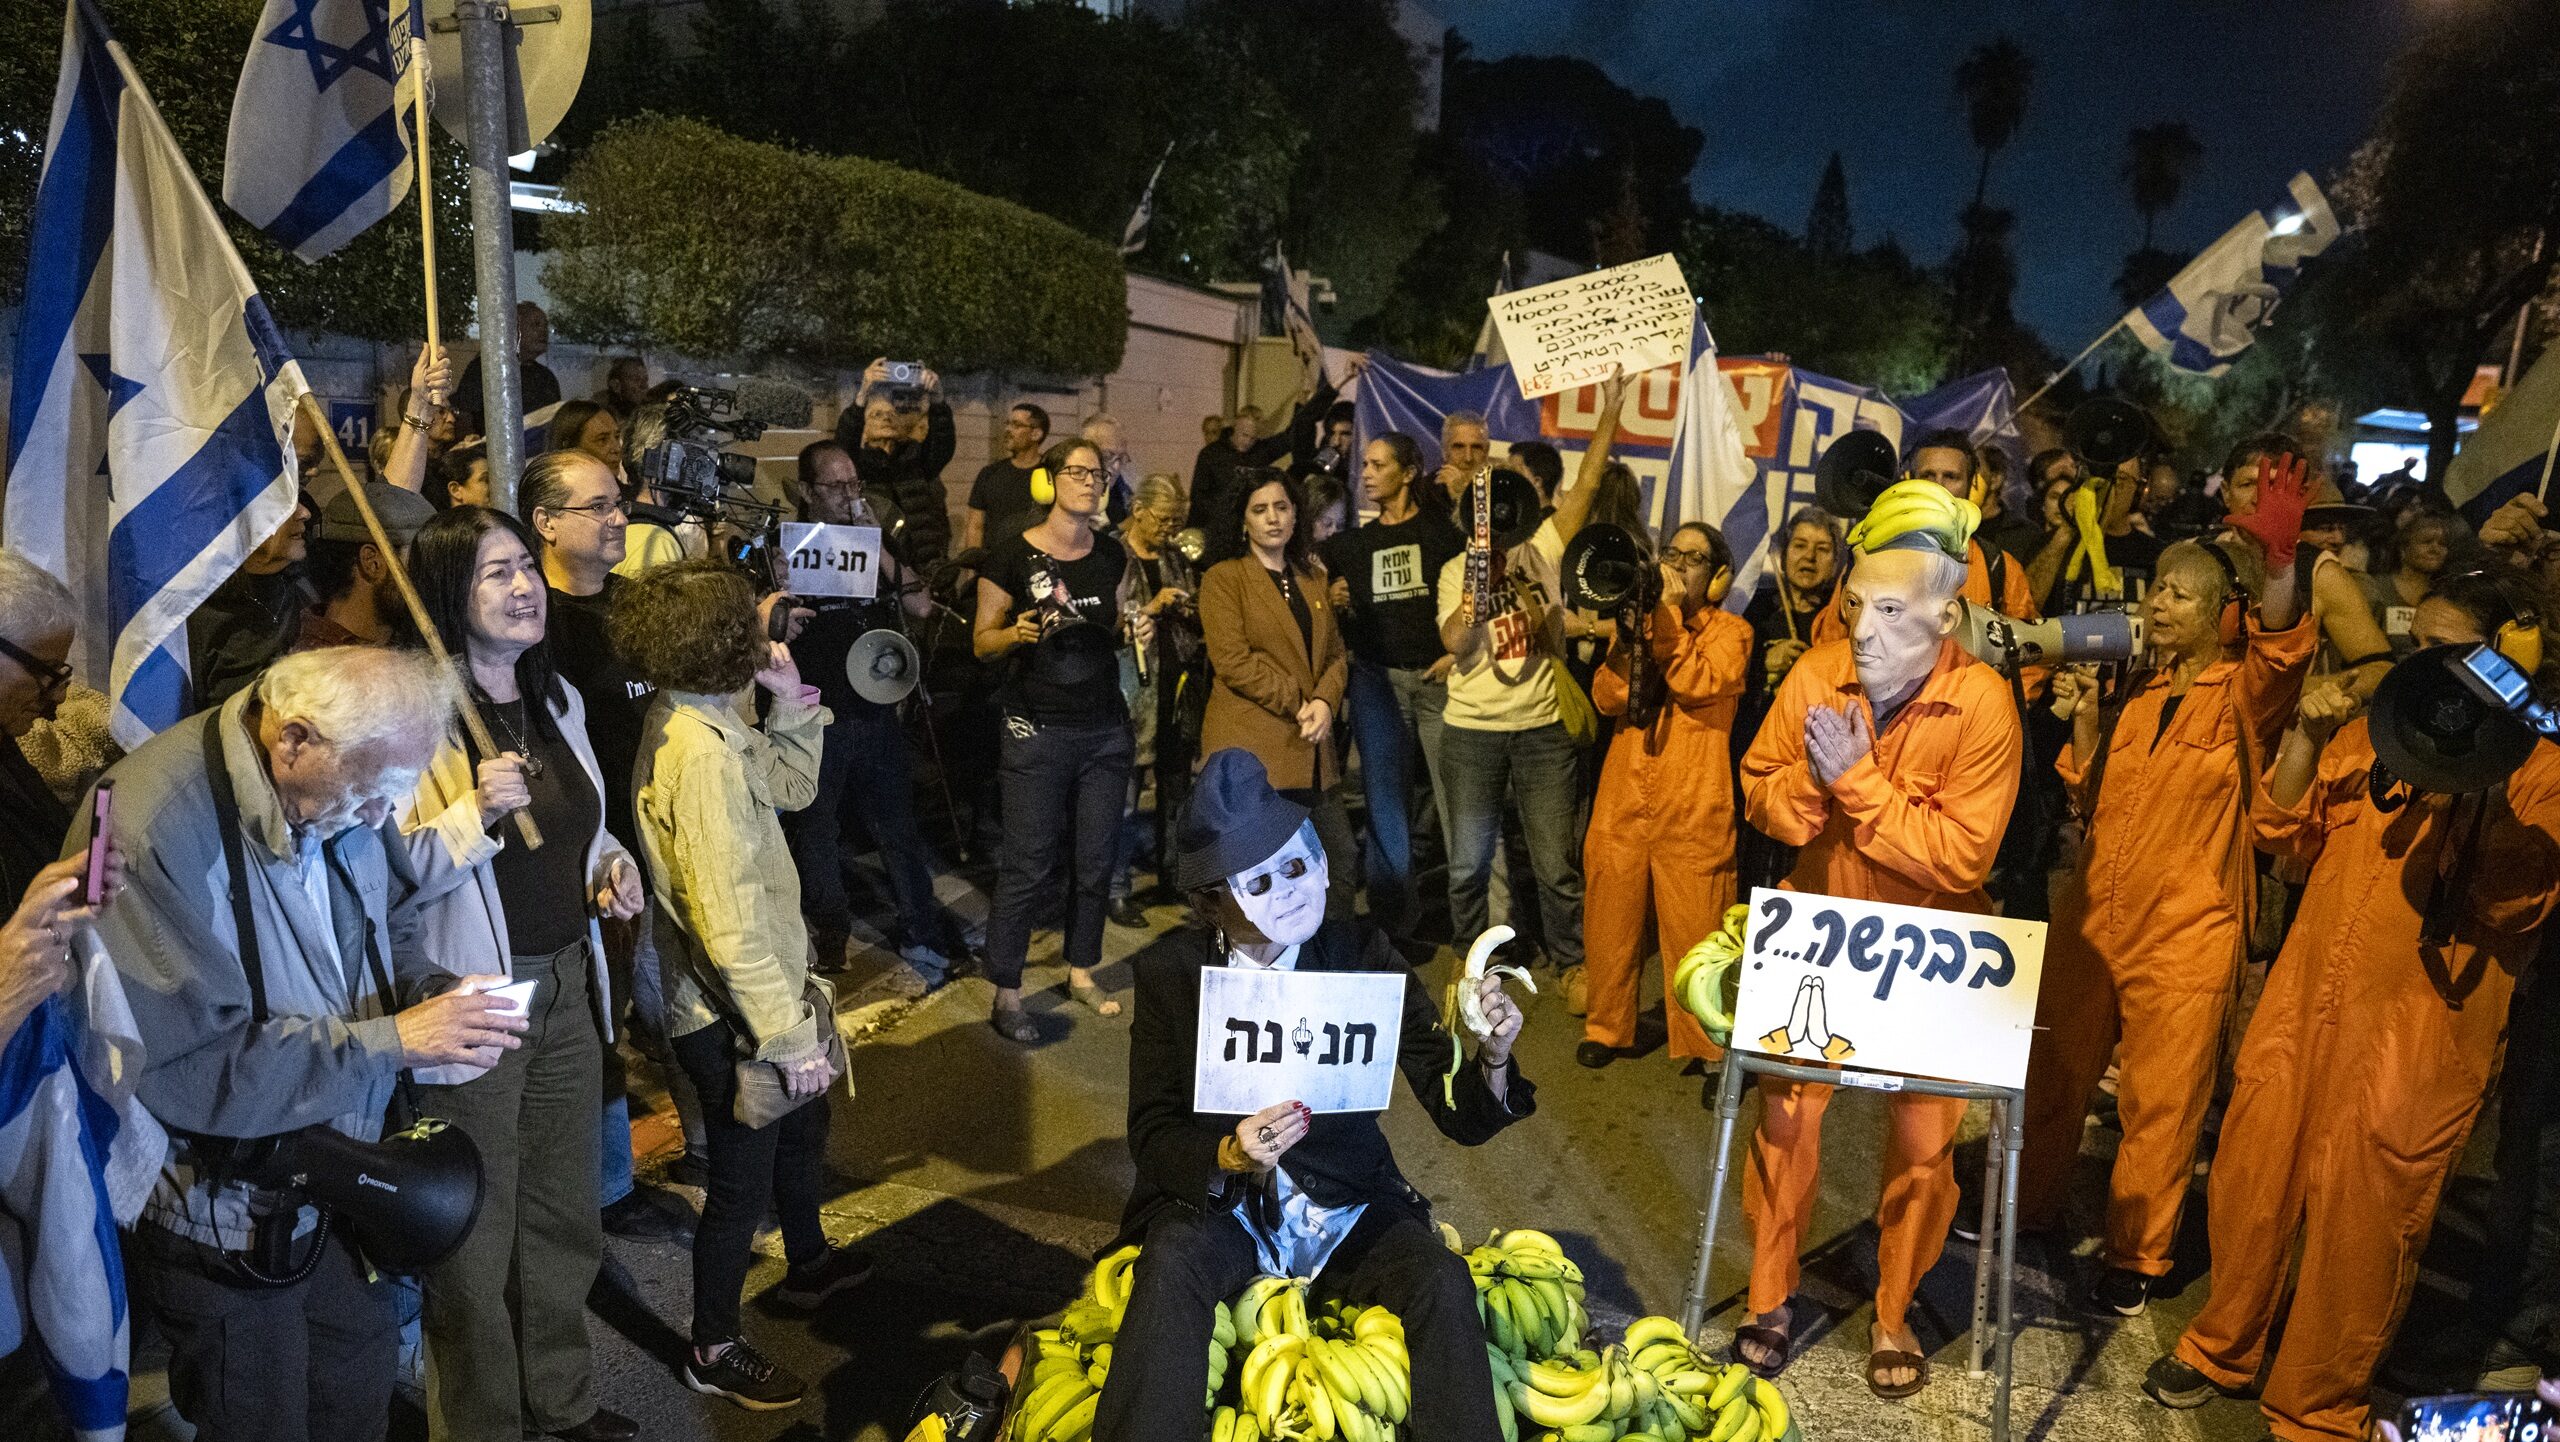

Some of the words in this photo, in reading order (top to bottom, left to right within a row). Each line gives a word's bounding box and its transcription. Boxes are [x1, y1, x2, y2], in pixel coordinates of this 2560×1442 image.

[1502, 289, 1569, 310] 1000
[1577, 273, 1639, 293] 2000
[1507, 303, 1568, 324] 4000
[338, 415, 369, 447] 41
[1382, 550, 1410, 569] אמא
[626, 680, 646, 699] I'm
[1223, 1017, 1377, 1067] חננה
[366, 1177, 399, 1193] PROXTONE
